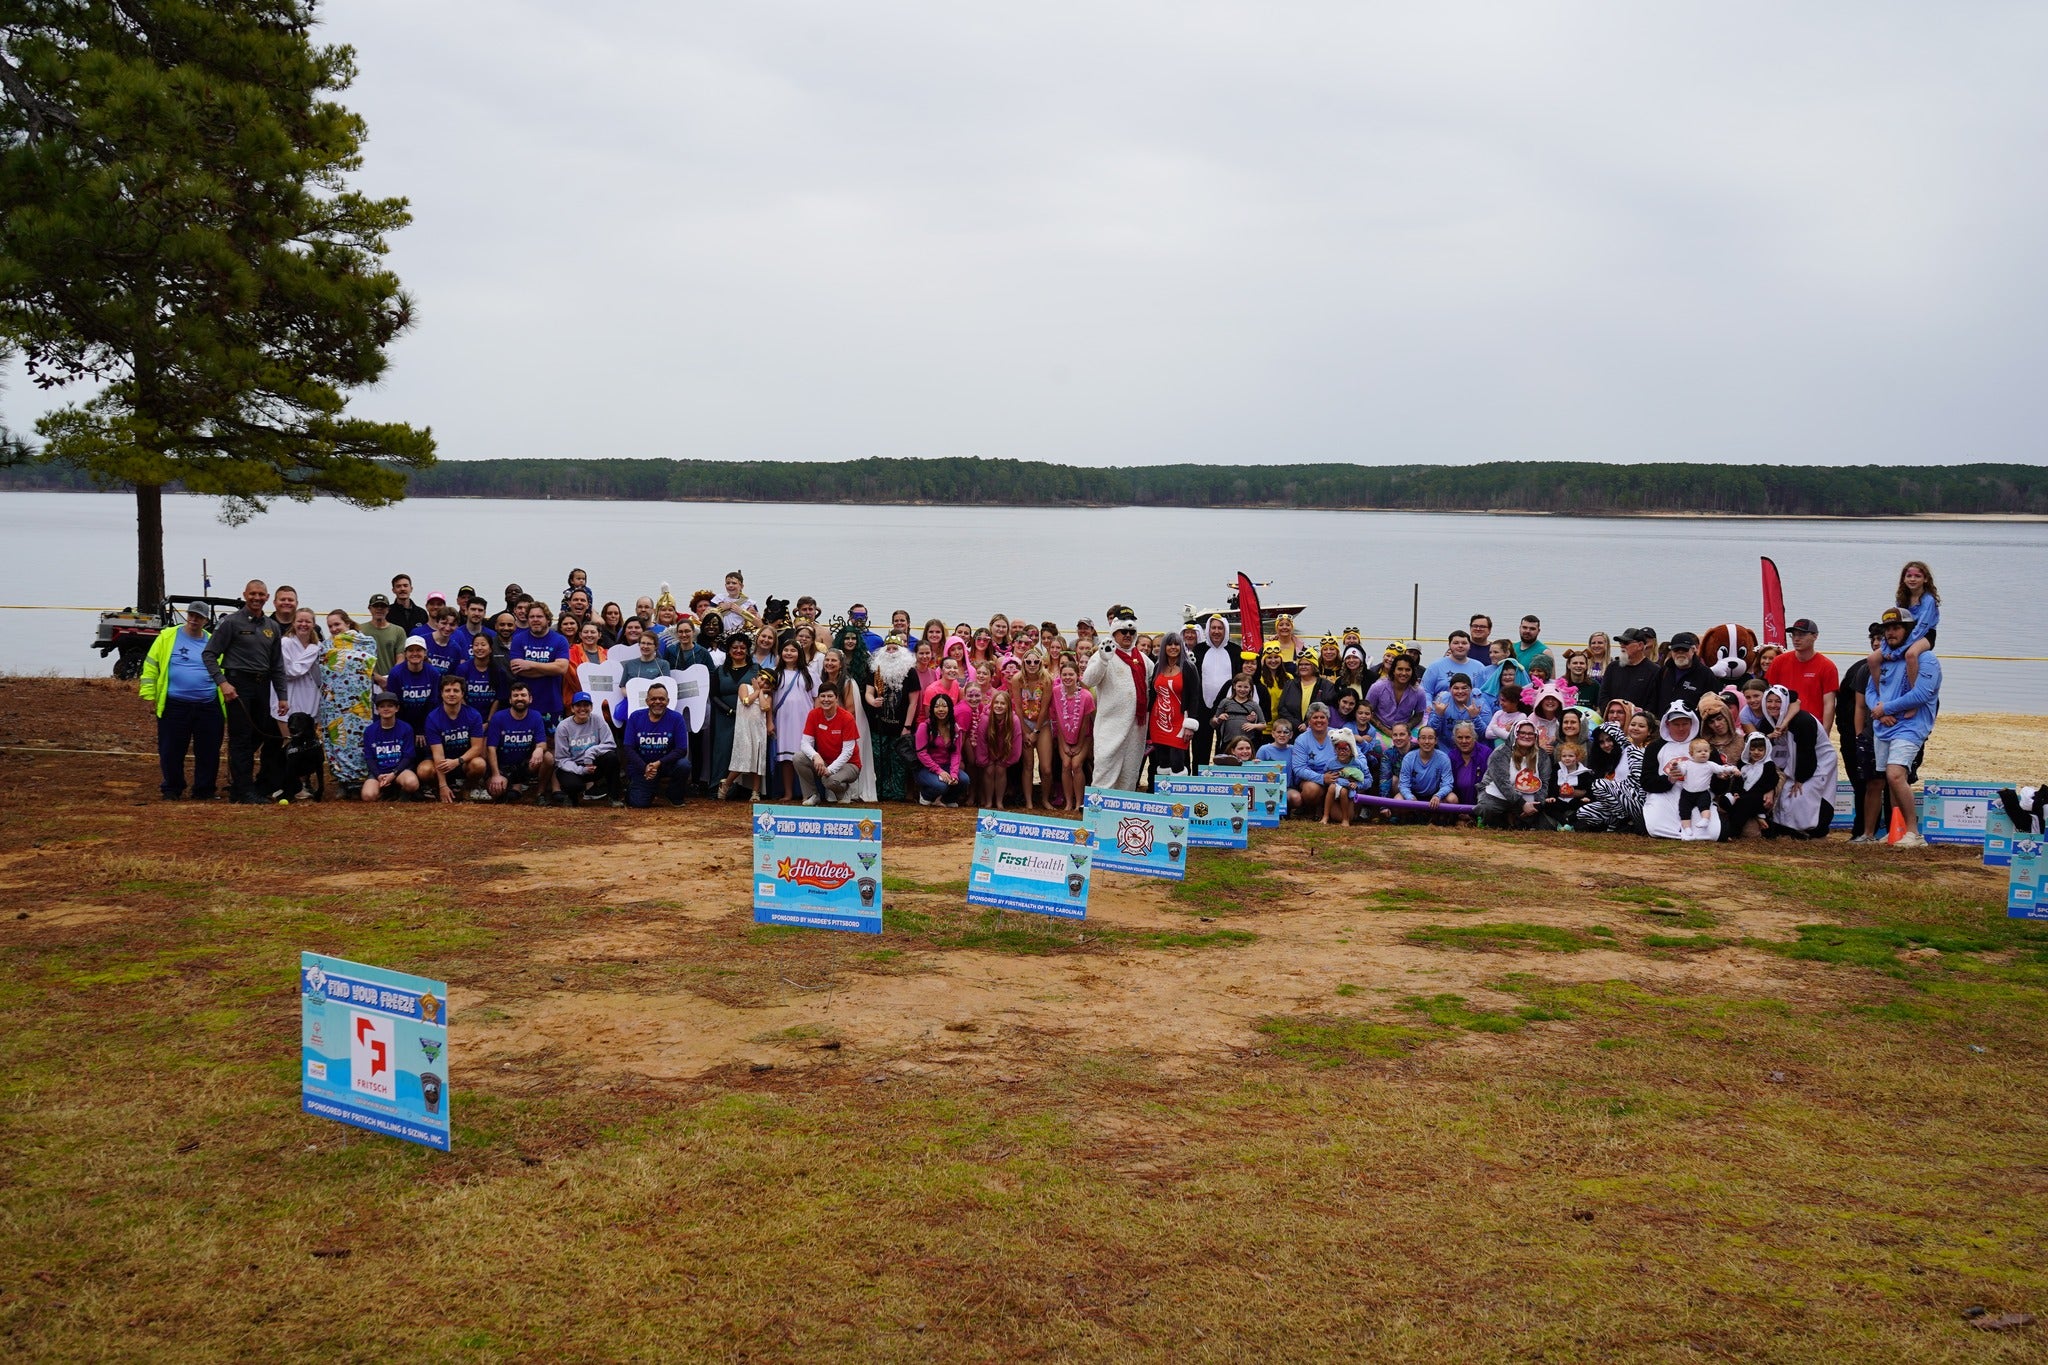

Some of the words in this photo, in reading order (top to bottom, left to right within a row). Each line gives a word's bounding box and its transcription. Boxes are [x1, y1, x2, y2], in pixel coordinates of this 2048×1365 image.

[525, 650, 550, 659] POLAR
[504, 734, 533, 743] POLAR
[571, 735, 596, 747] POLAR
[640, 737, 669, 745] POLAR
[1172, 785, 1188, 793] FIND
[1189, 785, 1206, 793] YOUR
[1206, 785, 1229, 794] FREEZE
[1103, 799, 1120, 808] FIND
[1122, 800, 1141, 811] YOUR
[1142, 804, 1168, 814] FREEZE
[777, 820, 796, 833] FIND
[799, 821, 821, 834] YOUR
[823, 822, 854, 836] FREEZE
[999, 823, 1017, 834] FIND
[1019, 825, 1040, 837] YOUR
[1042, 828, 1070, 841] FREEZE
[998, 851, 1064, 871] FirstHealth
[969, 895, 997, 904] SPONSORED
[1005, 899, 1037, 909] FIRSTHEALTH
[1055, 906, 1084, 916] CAROLINAS
[772, 914, 800, 922] SPONSORED
[807, 916, 832, 925] HARDEE'S
[831, 919, 860, 928] PITTSBORO
[328, 979, 351, 998] FIND
[352, 985, 379, 1006] YOUR
[380, 991, 416, 1014] FREEZE
[357, 1079, 388, 1094] FRITSCH
[307, 1100, 343, 1117] SPONSORED
[342, 1110, 351, 1120] BY
[351, 1112, 377, 1127] FRITSCH
[376, 1119, 402, 1134] MILLING
[402, 1126, 407, 1134] &
[407, 1127, 431, 1142] SIZING,
[430, 1134, 444, 1146] INC.
